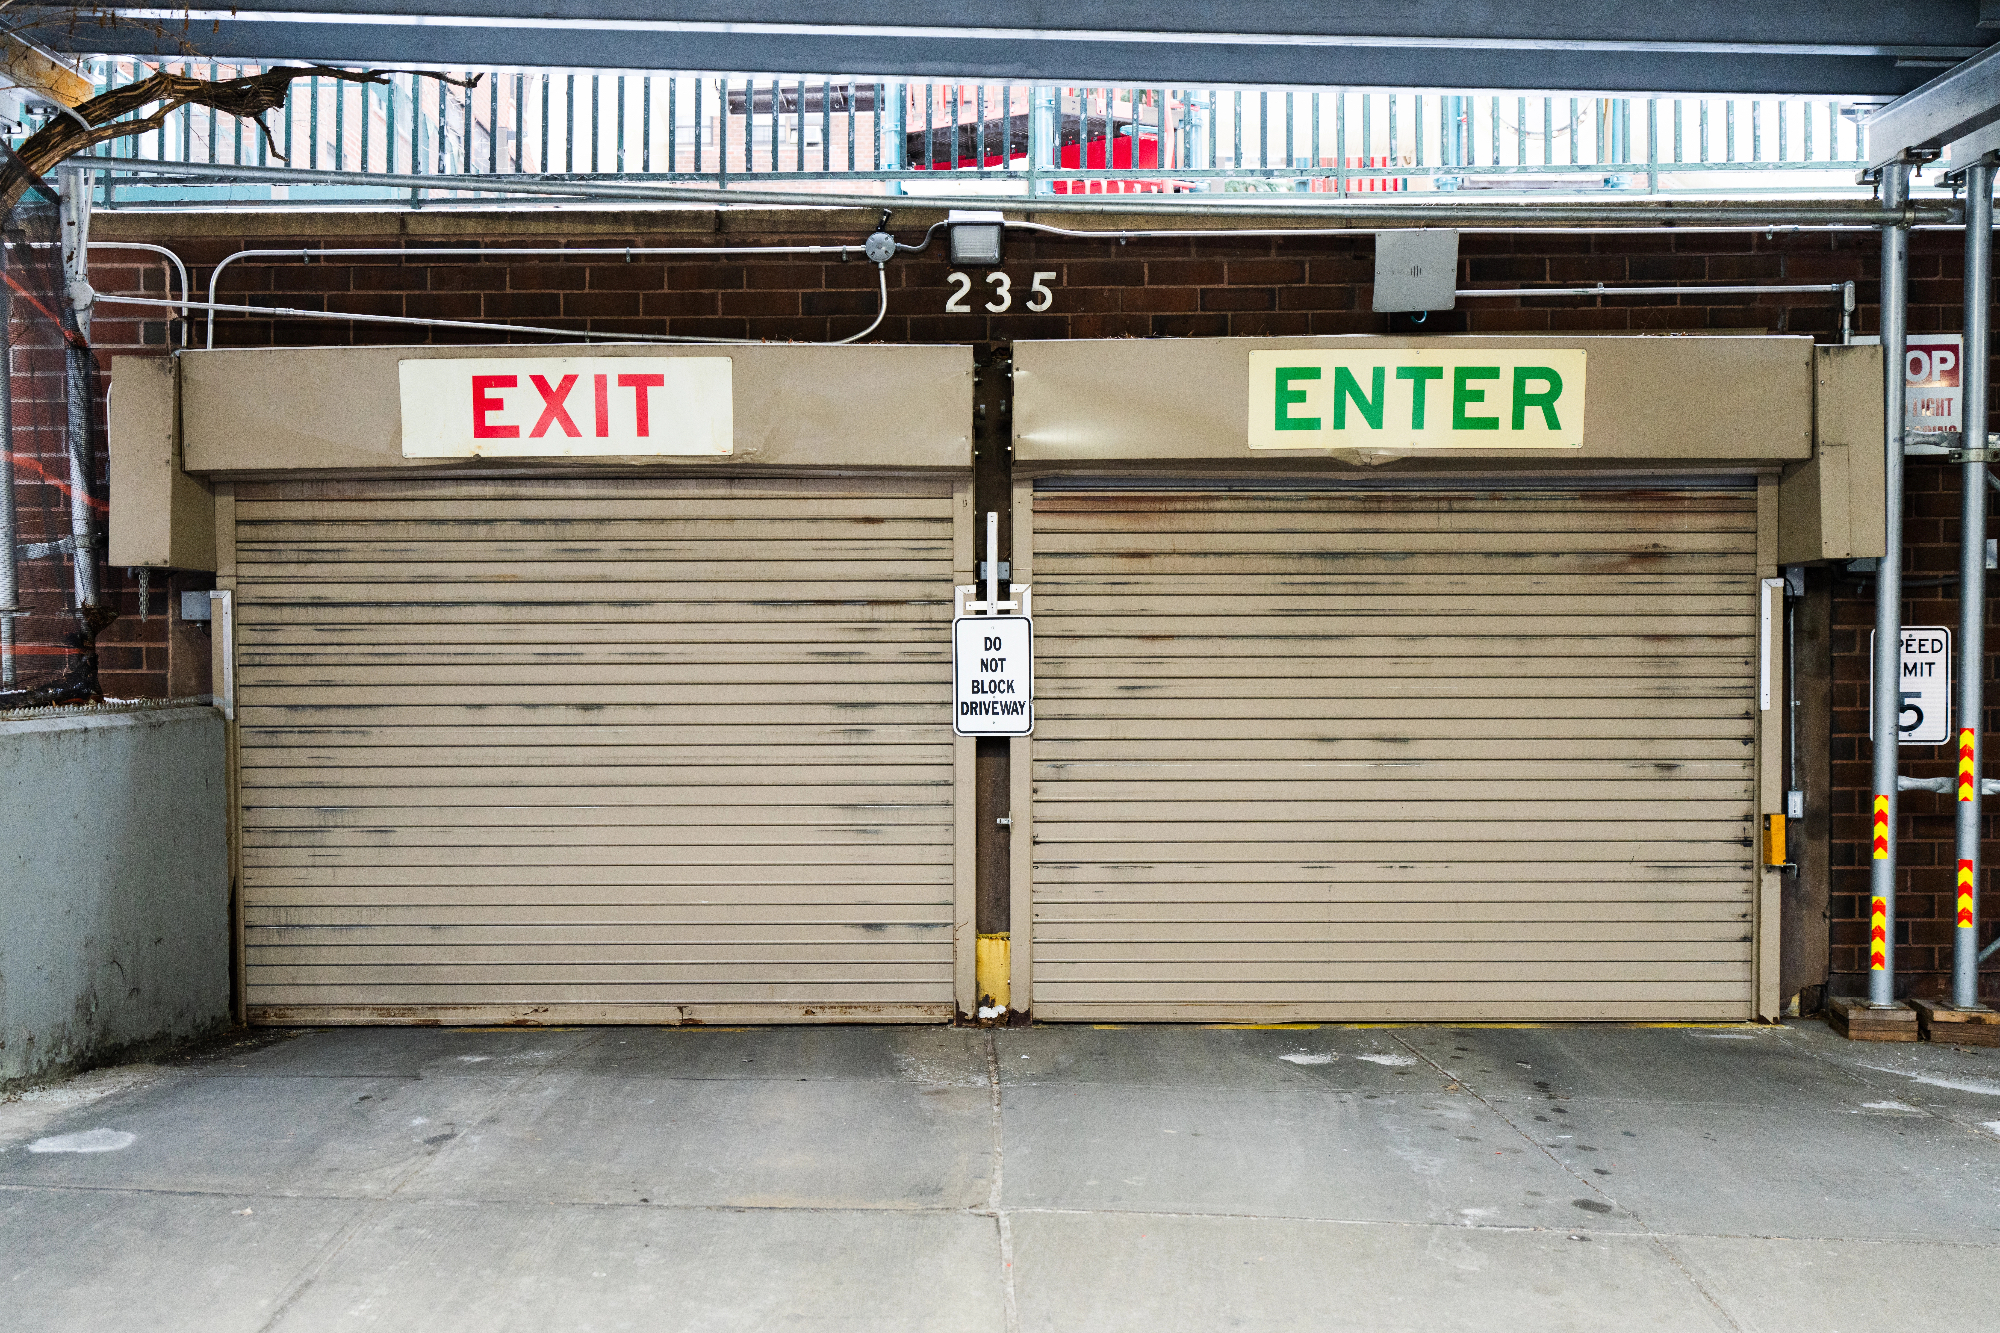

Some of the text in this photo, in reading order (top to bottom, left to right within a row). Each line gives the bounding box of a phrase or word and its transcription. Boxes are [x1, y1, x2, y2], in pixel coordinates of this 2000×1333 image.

[945, 271, 1057, 313] 235
[1905, 349, 1956, 382] OP
[471, 373, 665, 439] EXIT
[1274, 366, 1564, 431] ENTER
[1912, 397, 1954, 417] LIGHT
[983, 636, 1002, 652] DO
[1900, 638, 1944, 654] EED
[980, 657, 1007, 673] NOT
[1903, 661, 1936, 677] MIT
[971, 679, 1016, 695] BLOCK
[960, 700, 1027, 716] DRIVEWAY
[1898, 691, 1924, 733] 5
